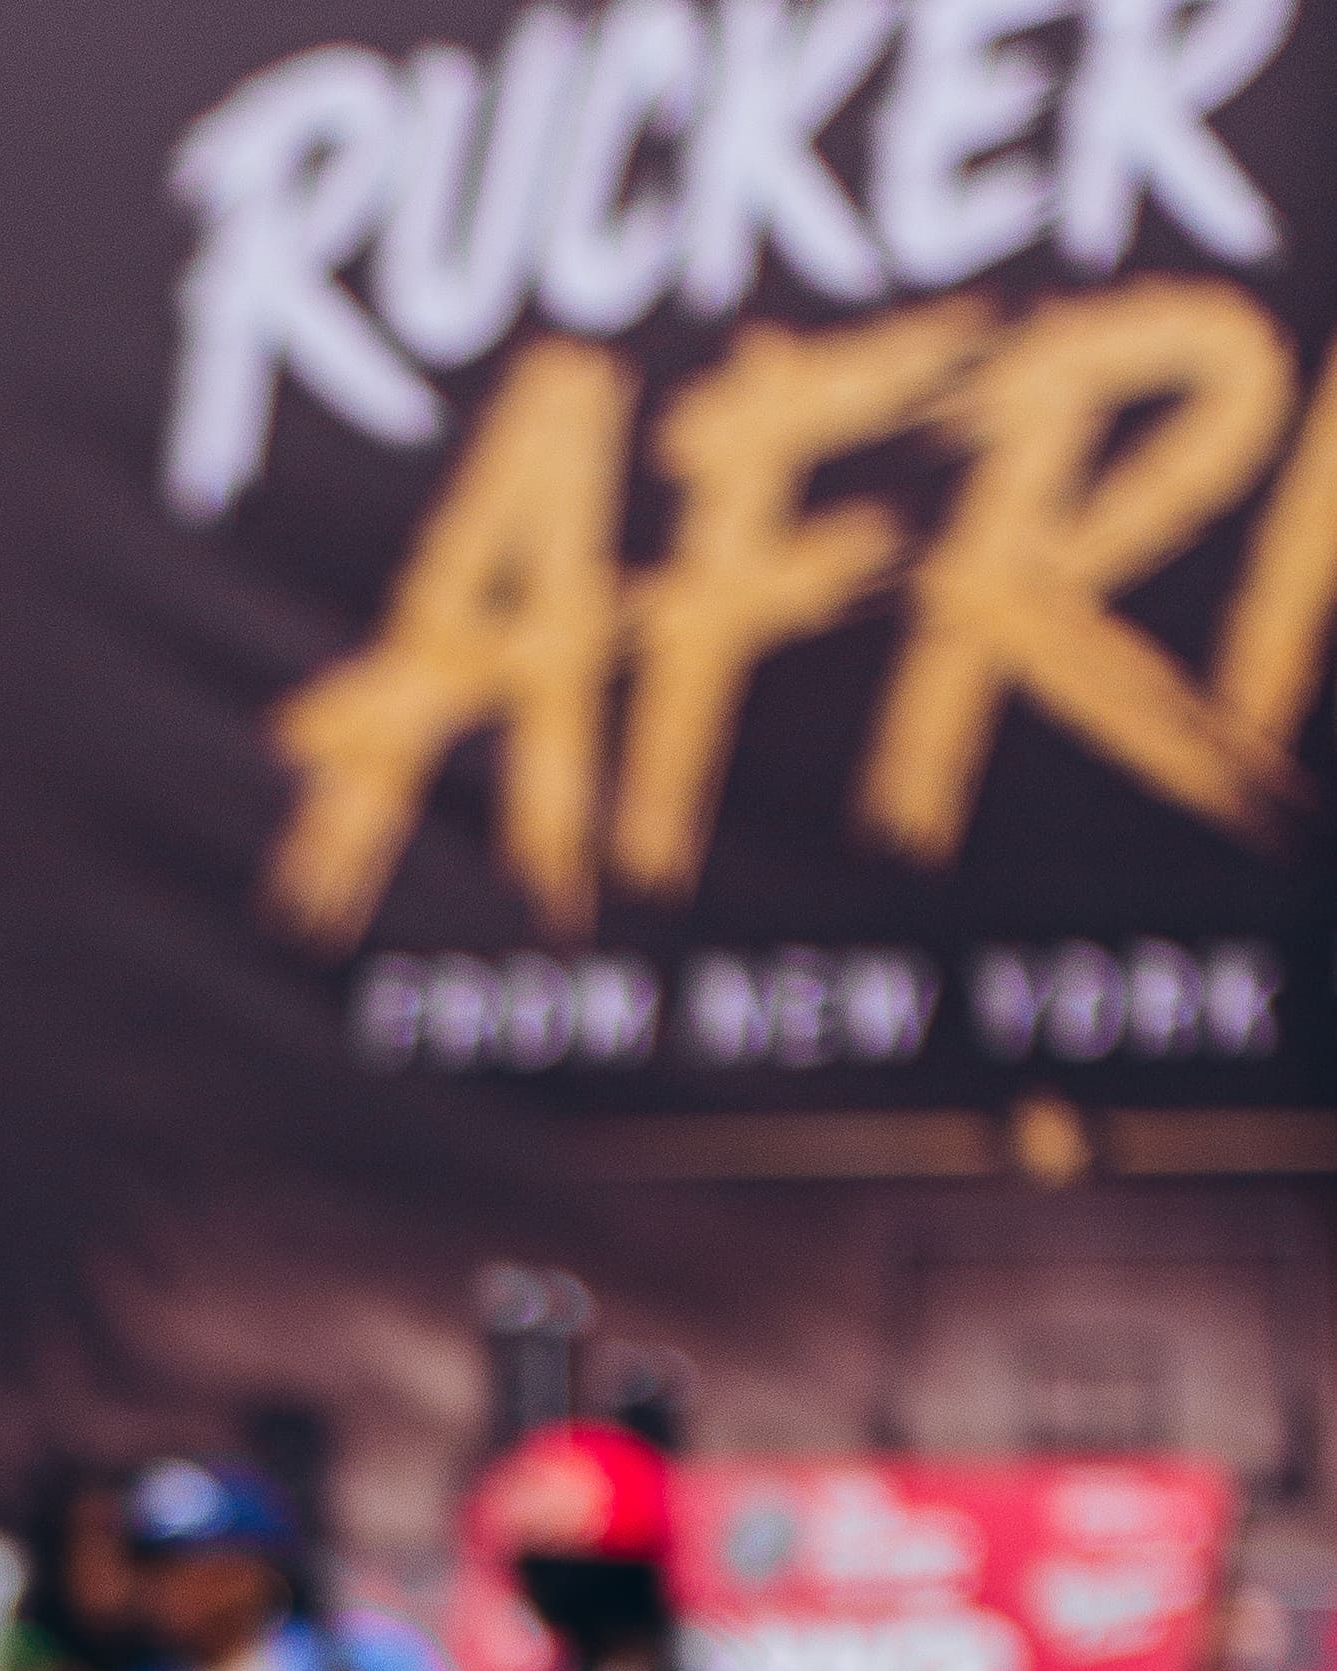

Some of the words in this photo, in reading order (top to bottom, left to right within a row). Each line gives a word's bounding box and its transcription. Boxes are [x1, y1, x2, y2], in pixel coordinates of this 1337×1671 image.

[163, 0, 1293, 522] RUCKER
[351, 952, 657, 1074] FROM
[681, 946, 937, 1068] NEW
[971, 938, 1283, 1060] YORK
